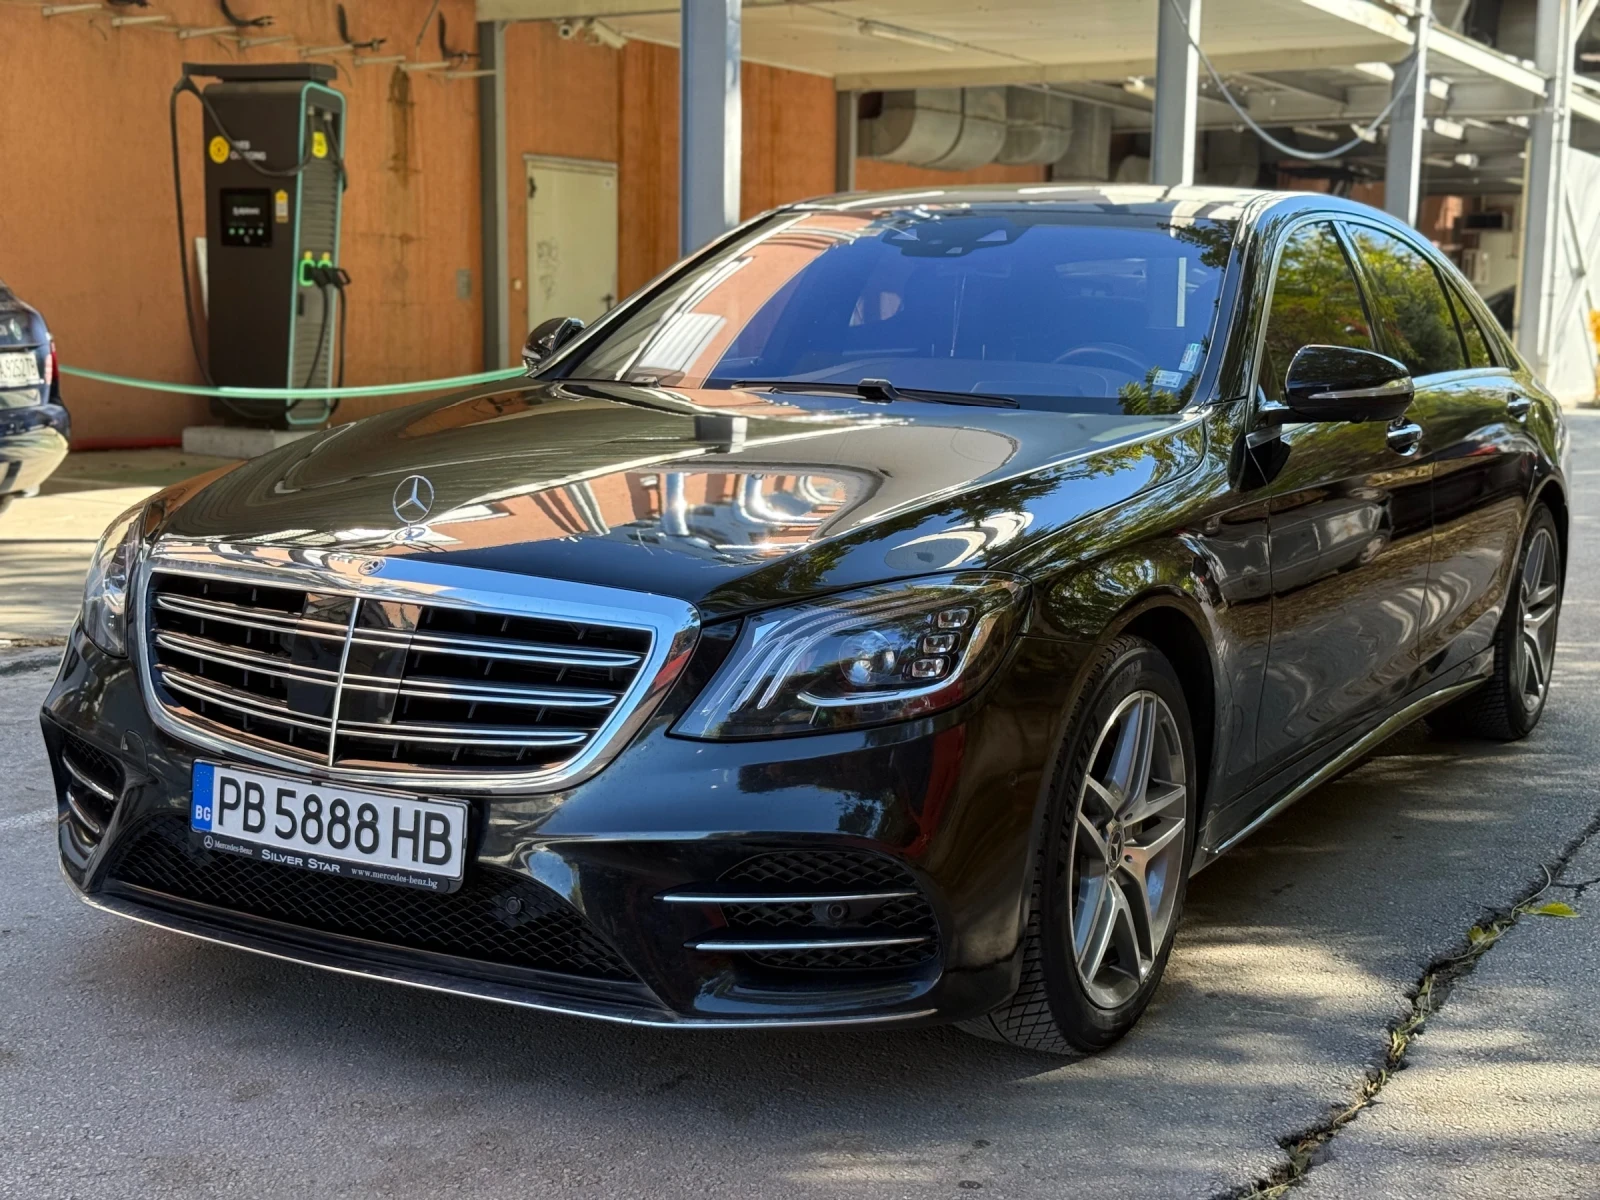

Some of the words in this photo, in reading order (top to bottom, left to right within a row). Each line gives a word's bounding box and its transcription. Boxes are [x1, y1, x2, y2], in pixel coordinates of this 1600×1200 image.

[195, 805, 211, 821] BG
[218, 776, 266, 833] PB
[275, 787, 379, 854] 5888
[391, 806, 452, 866] HB
[214, 839, 253, 855] Mercedes-Benz
[351, 867, 438, 889] www.mercedes-benz.bg
